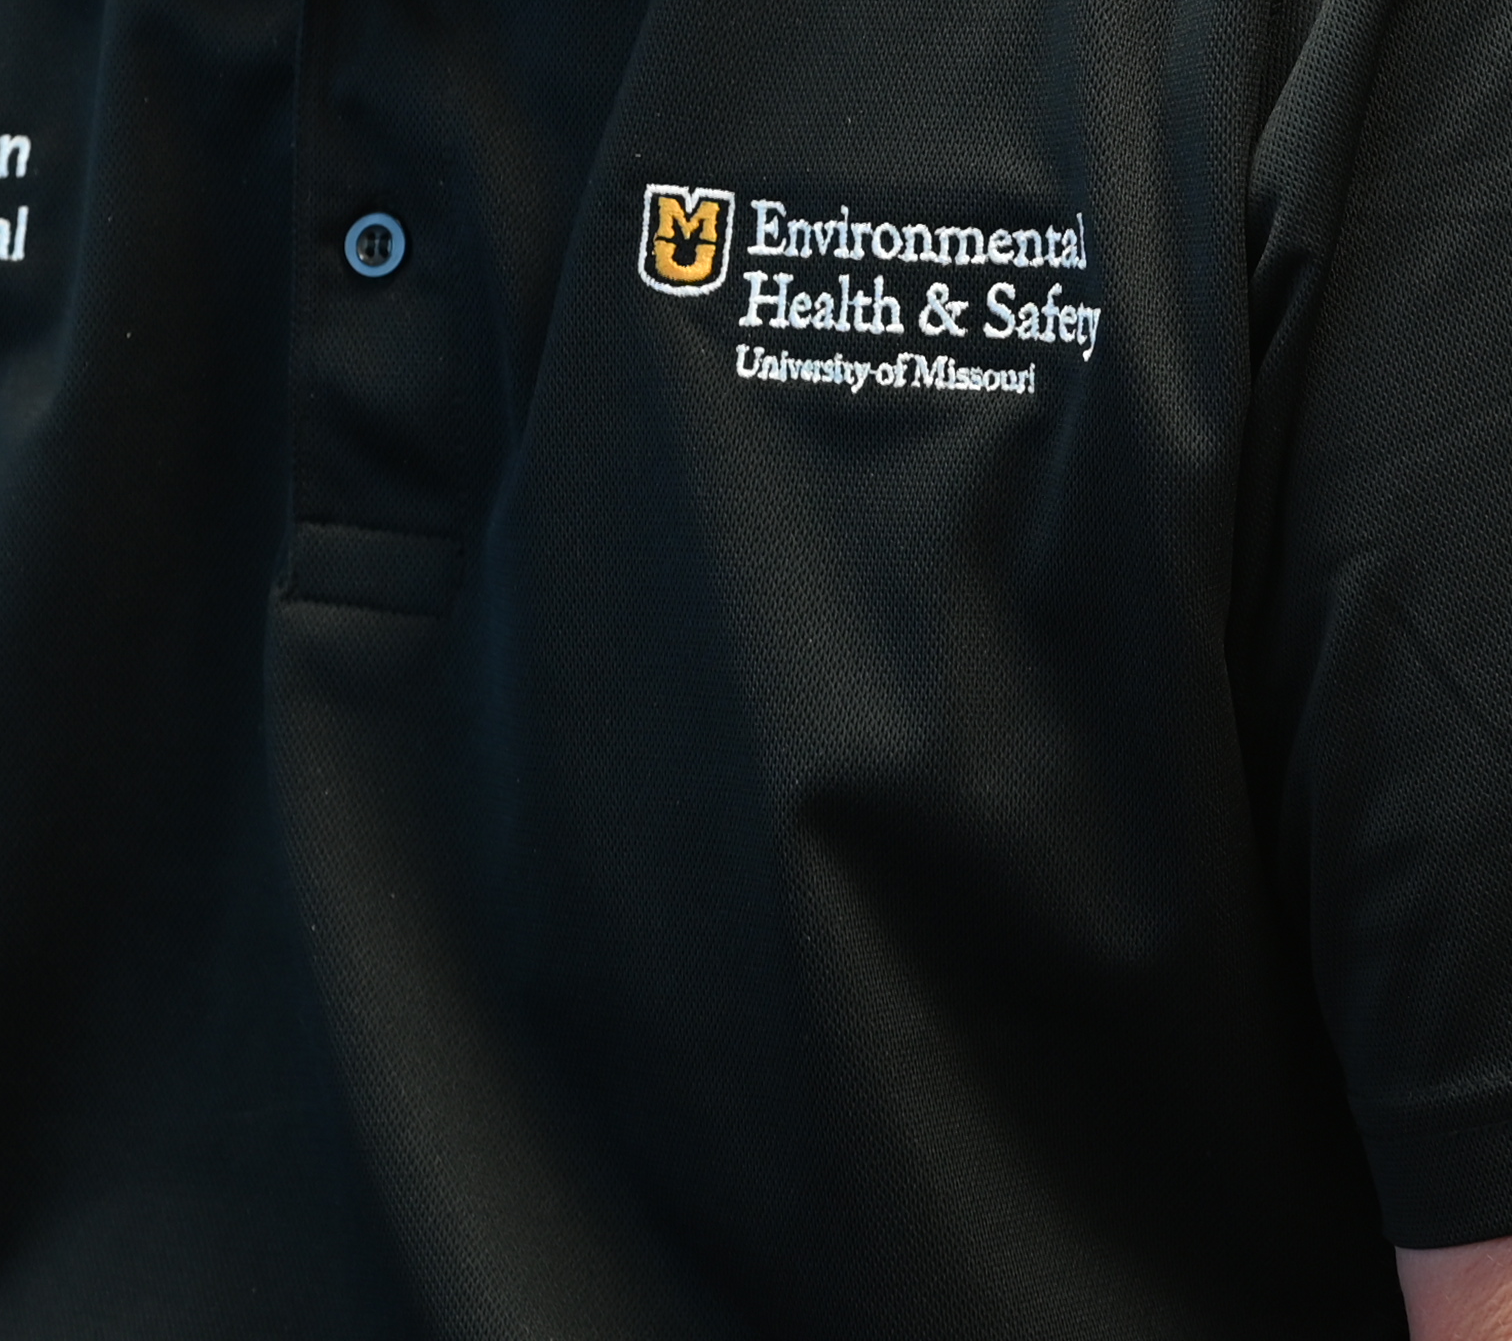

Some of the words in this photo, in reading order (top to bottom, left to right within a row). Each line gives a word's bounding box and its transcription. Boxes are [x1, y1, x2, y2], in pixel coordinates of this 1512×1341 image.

[746, 198, 1087, 270] Environmental
[739, 270, 904, 335] Health
[918, 281, 970, 337] &
[983, 281, 1101, 362] Safety
[735, 343, 870, 394] University
[875, 351, 914, 388] of
[911, 353, 1036, 394] Missouri
